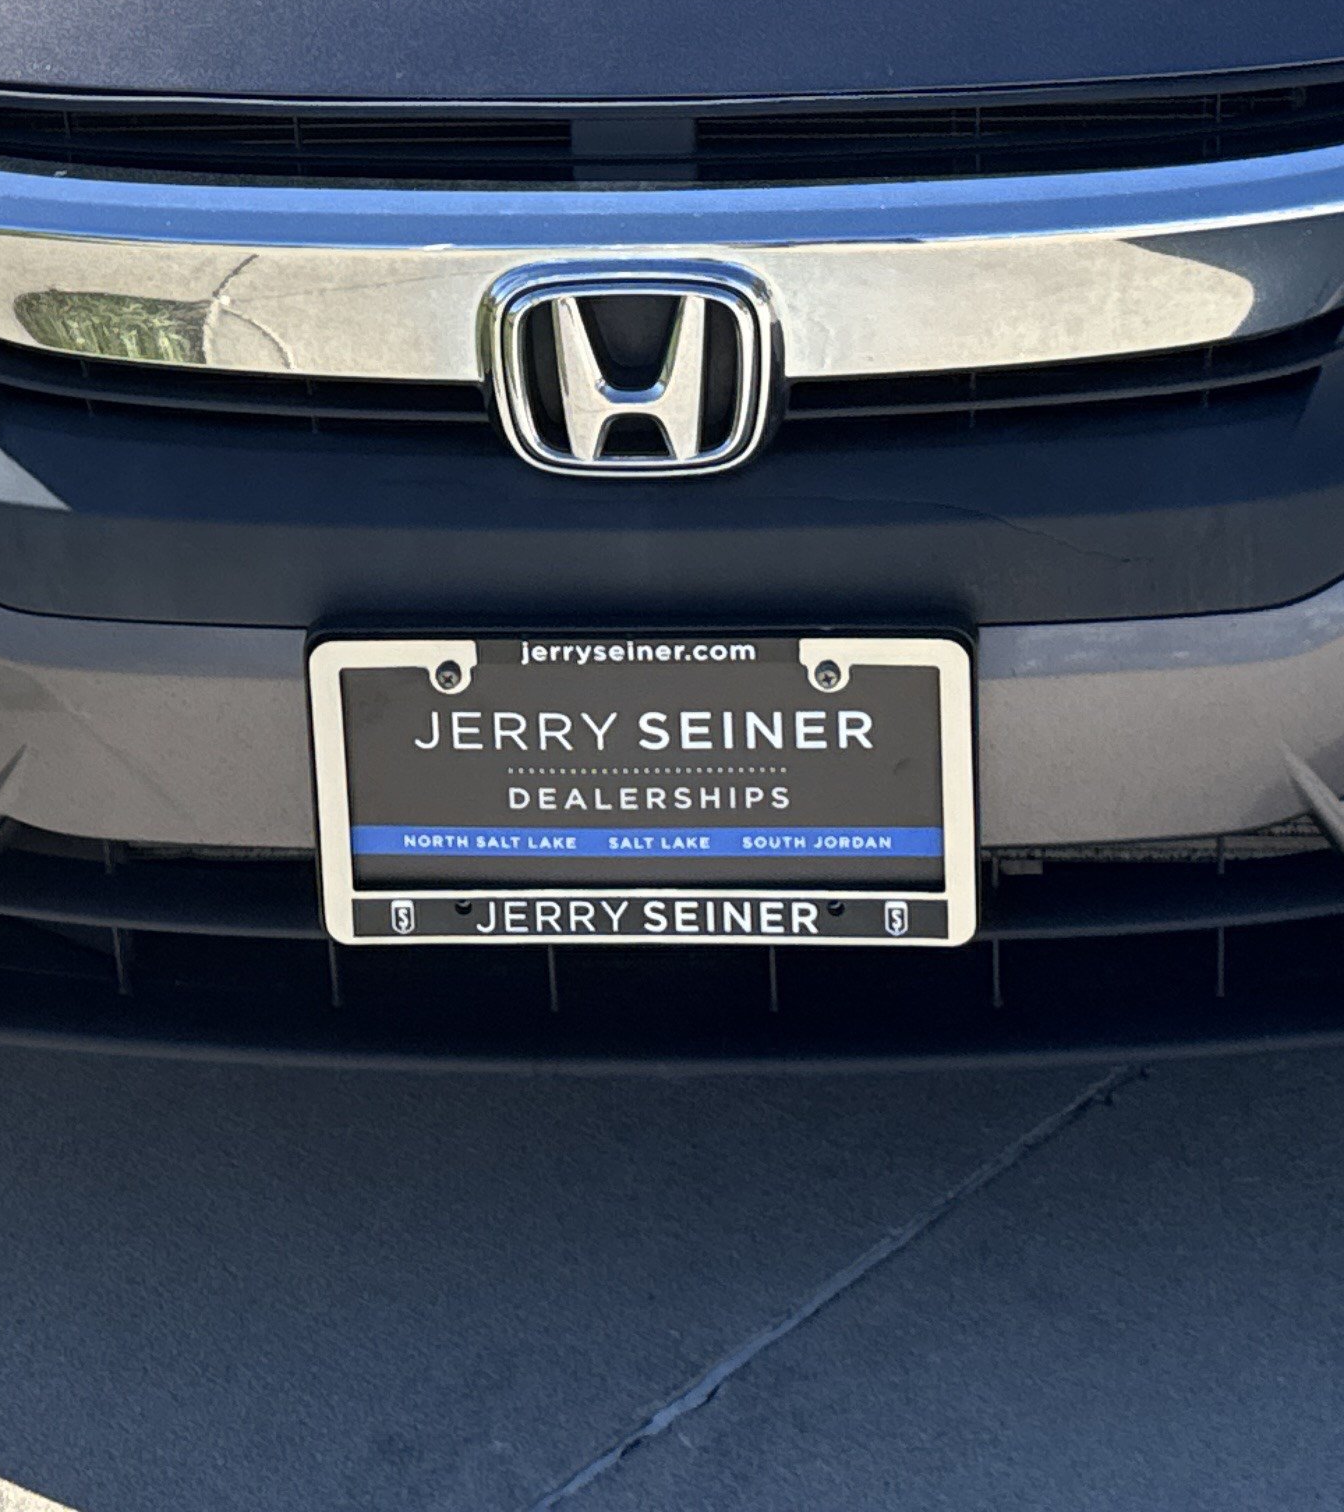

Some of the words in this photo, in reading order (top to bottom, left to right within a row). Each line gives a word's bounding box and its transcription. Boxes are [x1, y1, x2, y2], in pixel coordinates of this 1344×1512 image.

[520, 640, 757, 666] jerryseiner.com
[414, 711, 618, 751] JERRY
[637, 709, 875, 751] SEINER
[508, 786, 791, 811] DEALERSHIPS
[403, 834, 469, 849] NORTH
[476, 835, 520, 850] SALT
[527, 836, 578, 850] LAKE
[608, 836, 655, 850] SALT
[660, 836, 711, 850] LAKE
[741, 836, 807, 850] SOUTH
[813, 836, 893, 850] JORDAN
[475, 900, 629, 934] JERRY
[642, 900, 819, 935] SEINER
